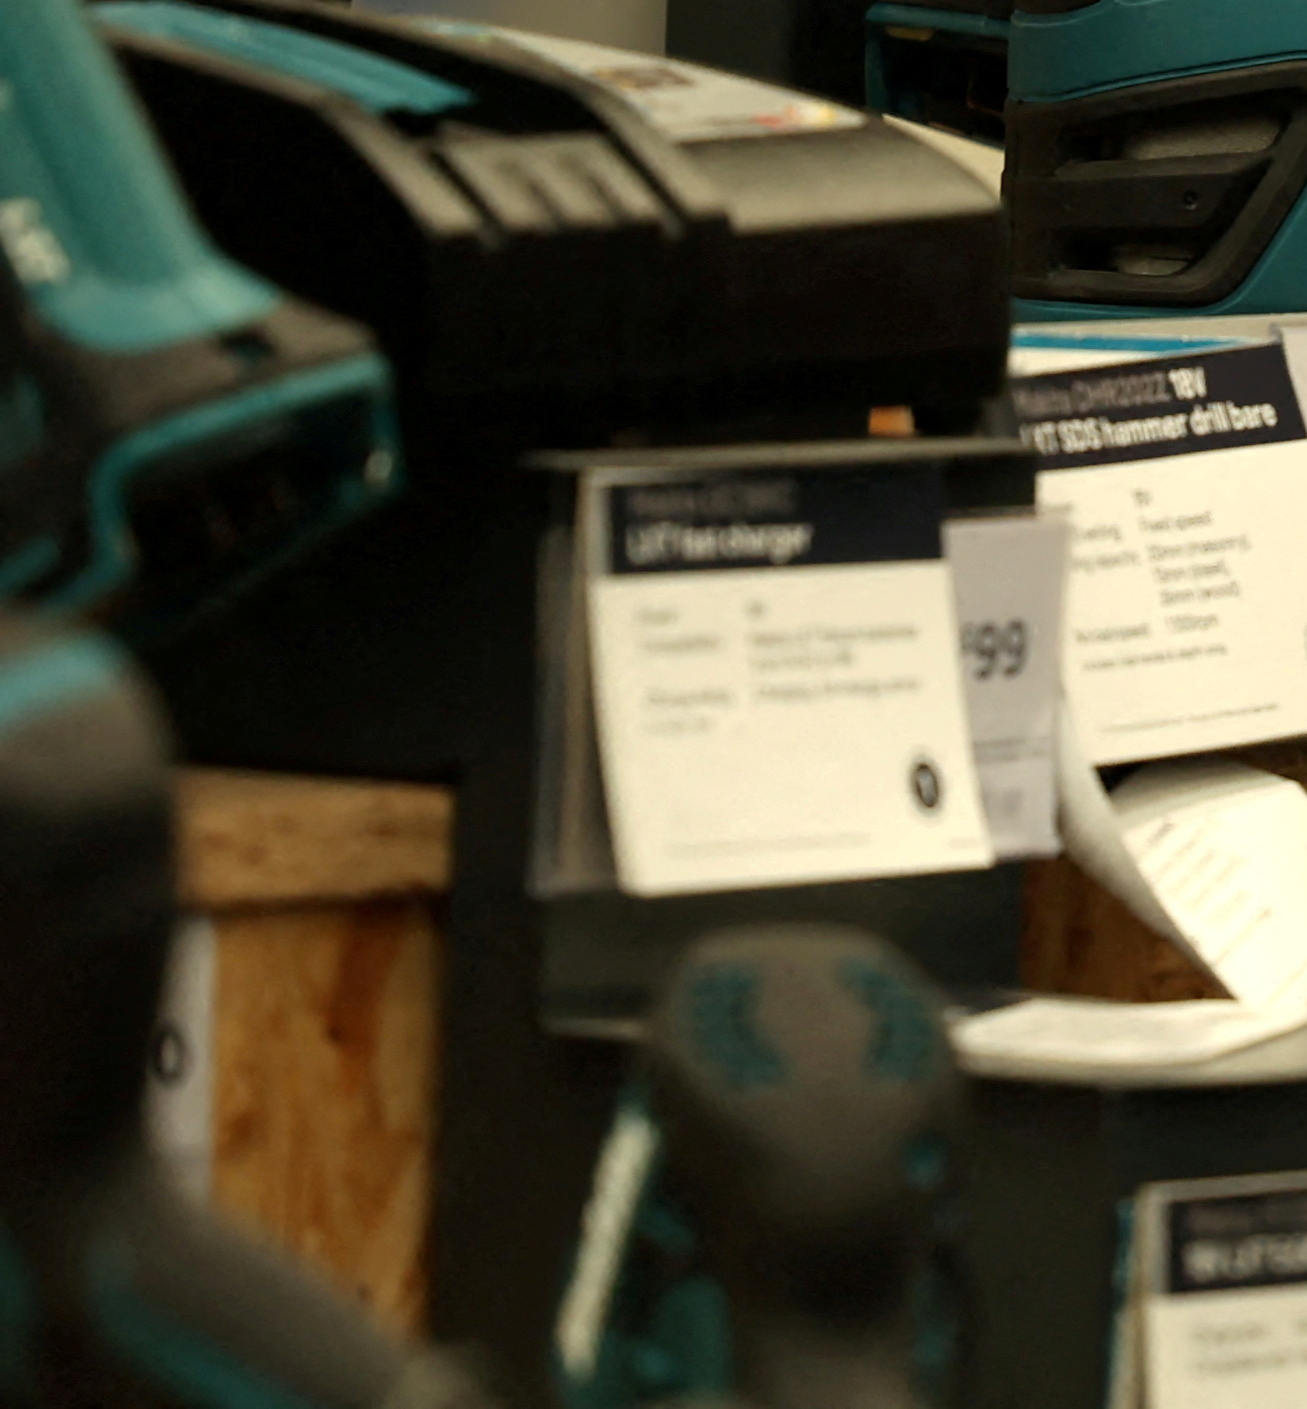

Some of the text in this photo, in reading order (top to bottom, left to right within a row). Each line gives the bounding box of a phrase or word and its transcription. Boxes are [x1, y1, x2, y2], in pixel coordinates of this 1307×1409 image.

[1101, 413, 1189, 447] hammer
[1189, 401, 1231, 436] drill
[1229, 402, 1278, 430] bare
